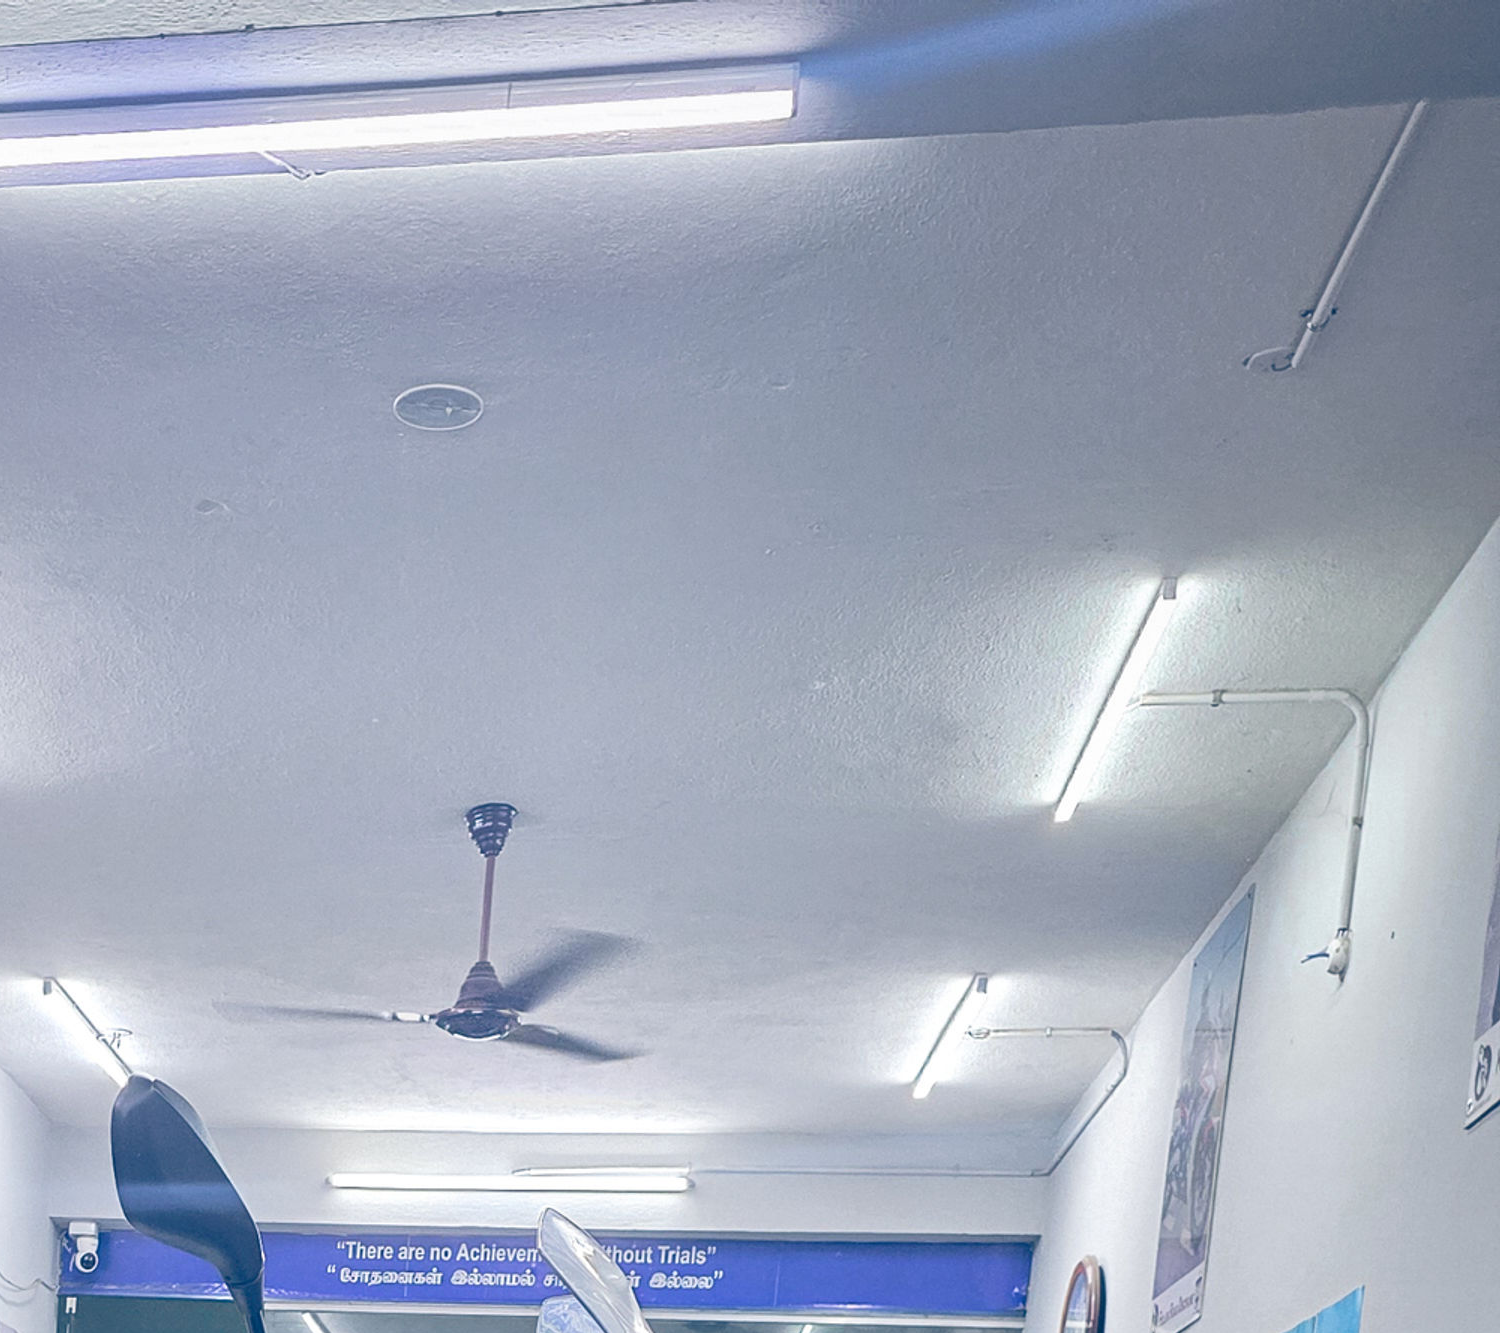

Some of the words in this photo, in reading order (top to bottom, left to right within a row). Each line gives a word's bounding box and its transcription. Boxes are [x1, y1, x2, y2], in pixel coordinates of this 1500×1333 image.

[398, 1246, 424, 1260] are
[430, 1248, 452, 1261] no
[456, 1243, 542, 1262] Achievem
[600, 1244, 653, 1264] thout
